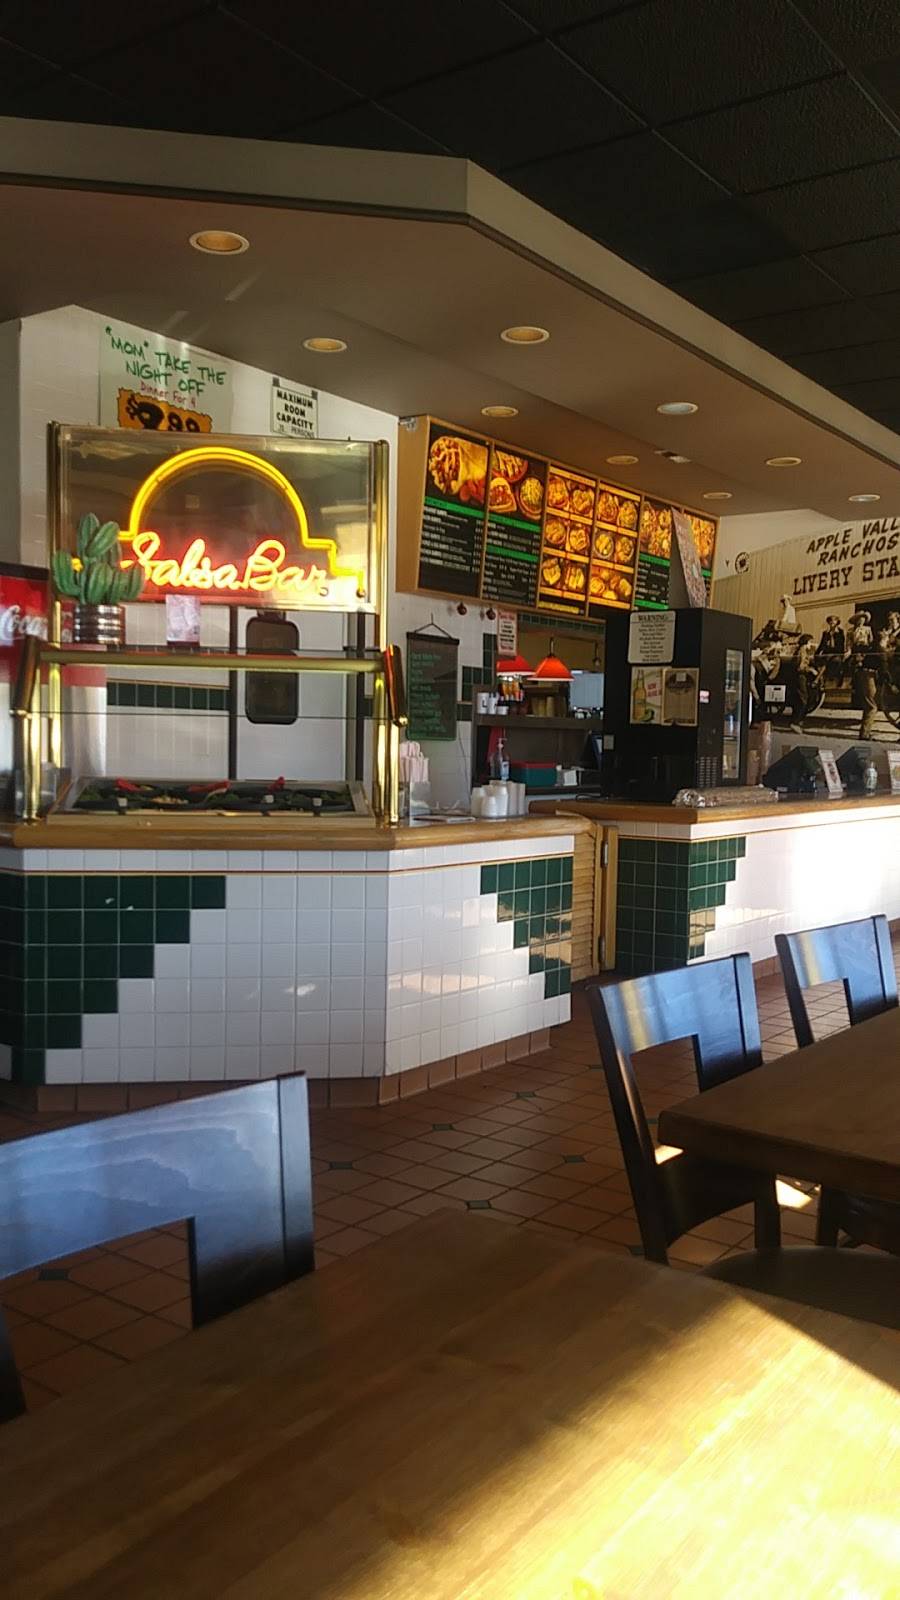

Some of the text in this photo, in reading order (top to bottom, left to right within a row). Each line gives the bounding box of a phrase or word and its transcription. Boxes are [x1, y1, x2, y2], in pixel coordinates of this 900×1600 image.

[126, 361, 206, 396] NIGHT OFF
[154, 352, 191, 374] TAKE
[197, 367, 227, 385] THE
[277, 389, 313, 408] MAXIMUM
[285, 402, 306, 418] ROOM
[276, 411, 313, 430] CAPACITY
[806, 528, 852, 554] APPLE
[817, 532, 900, 566] RANCHOS
[120, 530, 328, 593] Salsa Bar
[793, 566, 853, 595] LIVERY
